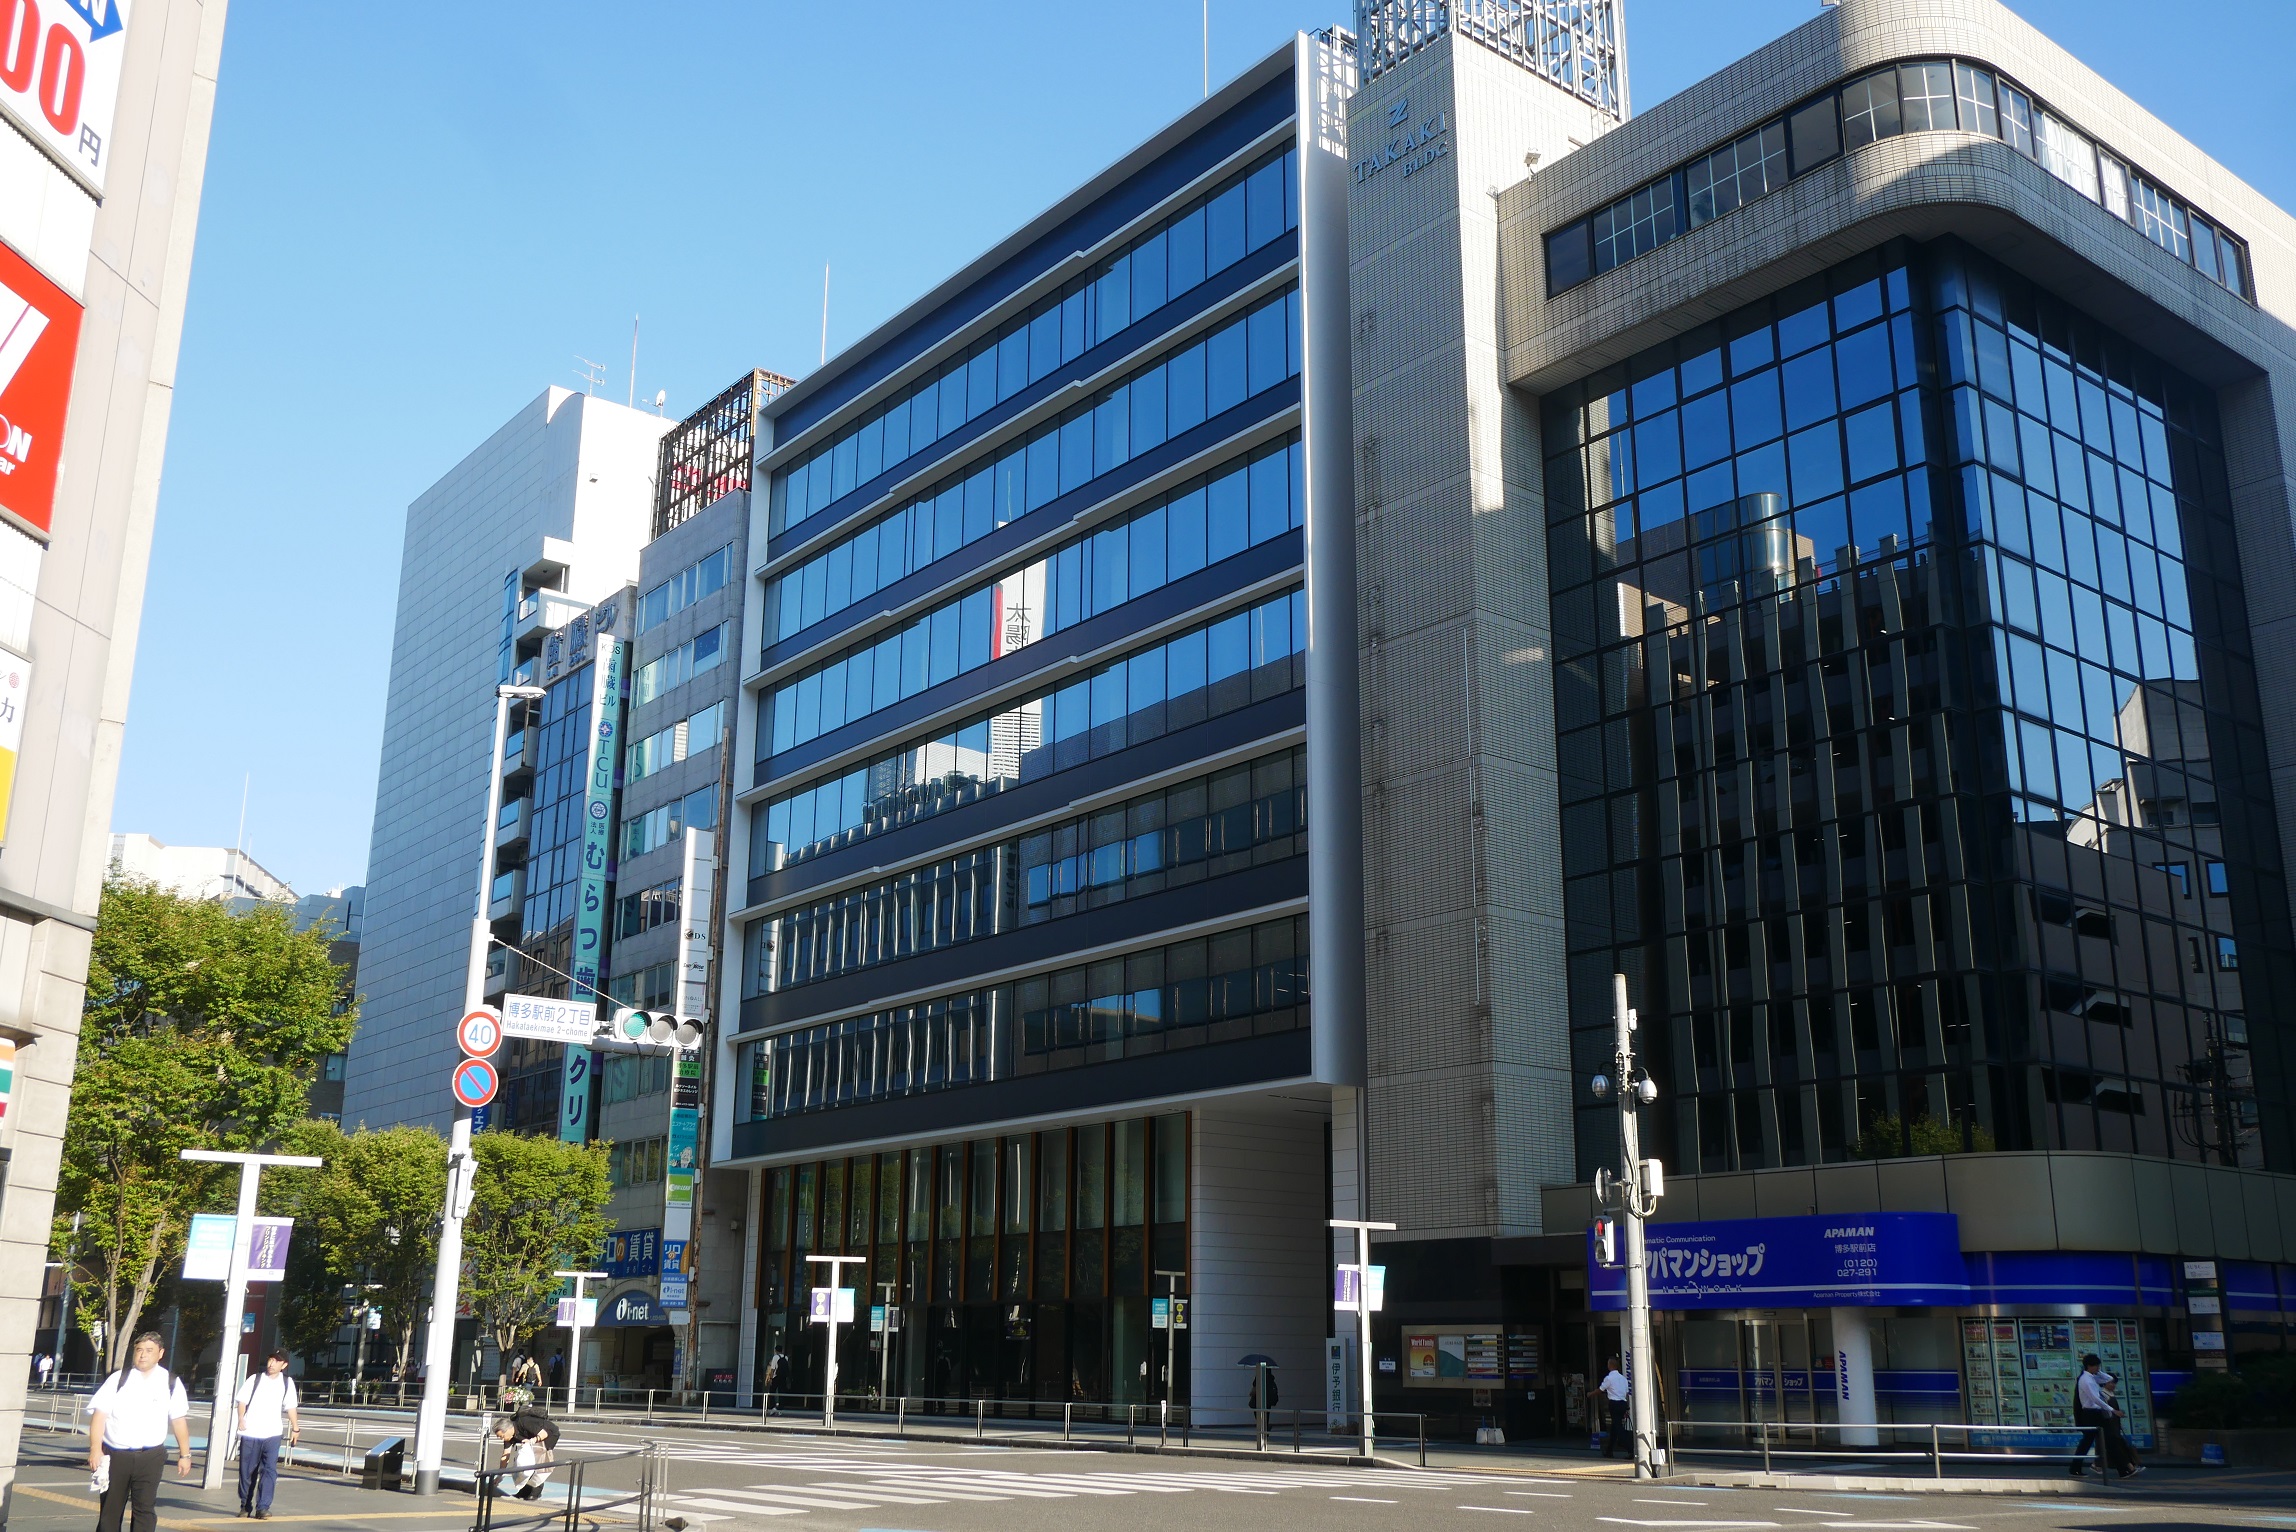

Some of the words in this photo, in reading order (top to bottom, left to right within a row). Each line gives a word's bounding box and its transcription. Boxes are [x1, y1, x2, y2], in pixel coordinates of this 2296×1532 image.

[1353, 111, 1447, 184] TAKAKI
[1403, 141, 1448, 178] BLDG
[595, 739, 610, 789] TCU
[508, 1001, 592, 1026] 博多駅前2丁目
[468, 1024, 492, 1045] 40
[506, 1019, 555, 1034] Hakataekimae
[556, 1026, 589, 1037] 2-chome
[1665, 1234, 1717, 1244] Communication
[1823, 1226, 1875, 1239] APAMAN
[1834, 1243, 1877, 1254] 博多駅前店
[1836, 1268, 1877, 1277] 027-291
[1843, 1258, 1878, 1269] (0120)
[626, 1302, 649, 1321] i-net
[1754, 1376, 1774, 1386] アパマン
[1783, 1377, 1804, 1387] ショップ
[1838, 1350, 1850, 1401] APAMAN
[1331, 1362, 1341, 1412] 伊予銀行
